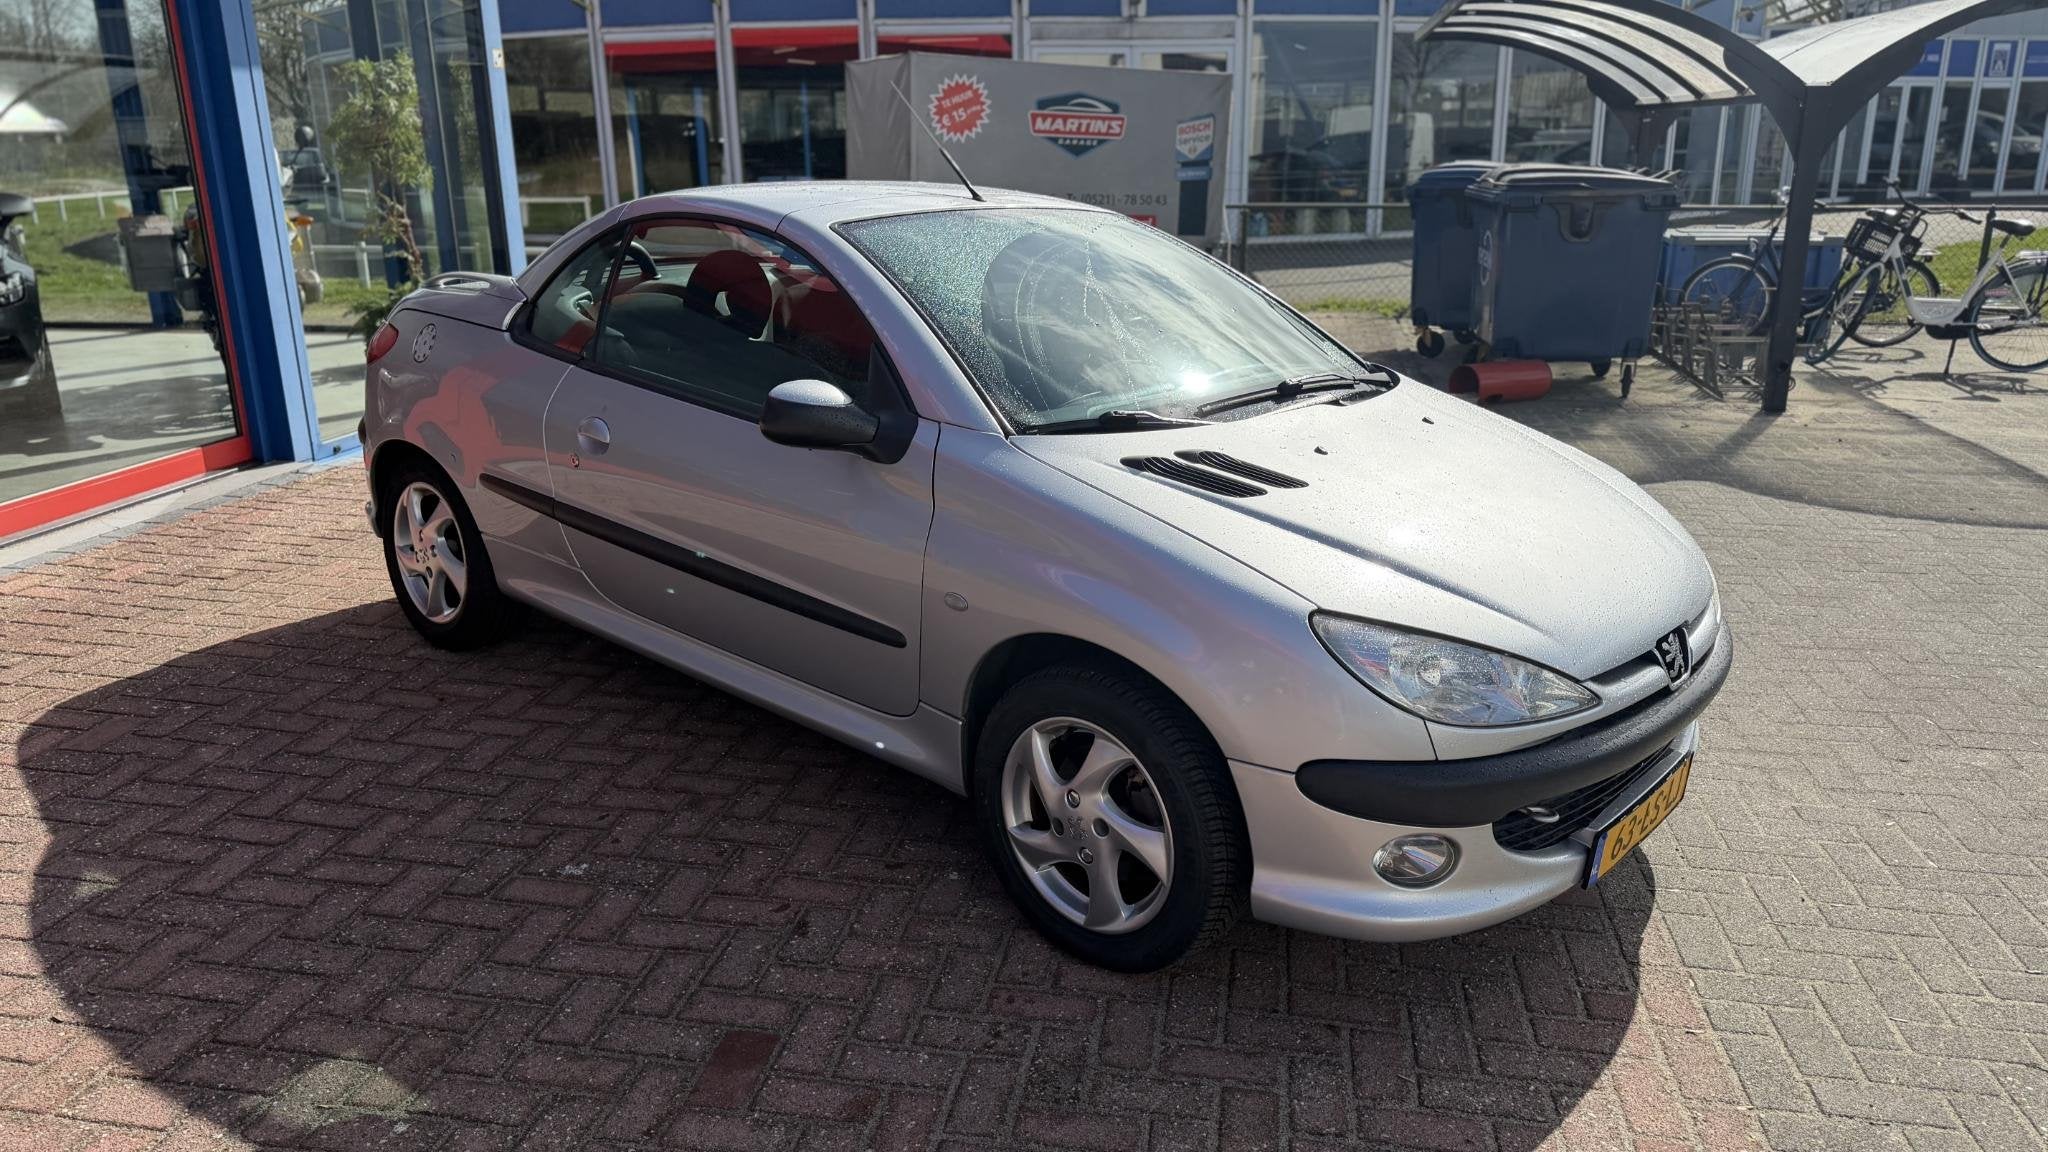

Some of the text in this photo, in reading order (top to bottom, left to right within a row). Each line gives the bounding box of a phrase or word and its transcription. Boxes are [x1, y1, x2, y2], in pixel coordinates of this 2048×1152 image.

[952, 107, 967, 122] 15
[1178, 122, 1211, 136] BOSCH
[1123, 194, 1137, 206] 78
[1139, 195, 1152, 206] 50
[1155, 195, 1168, 206] 43
